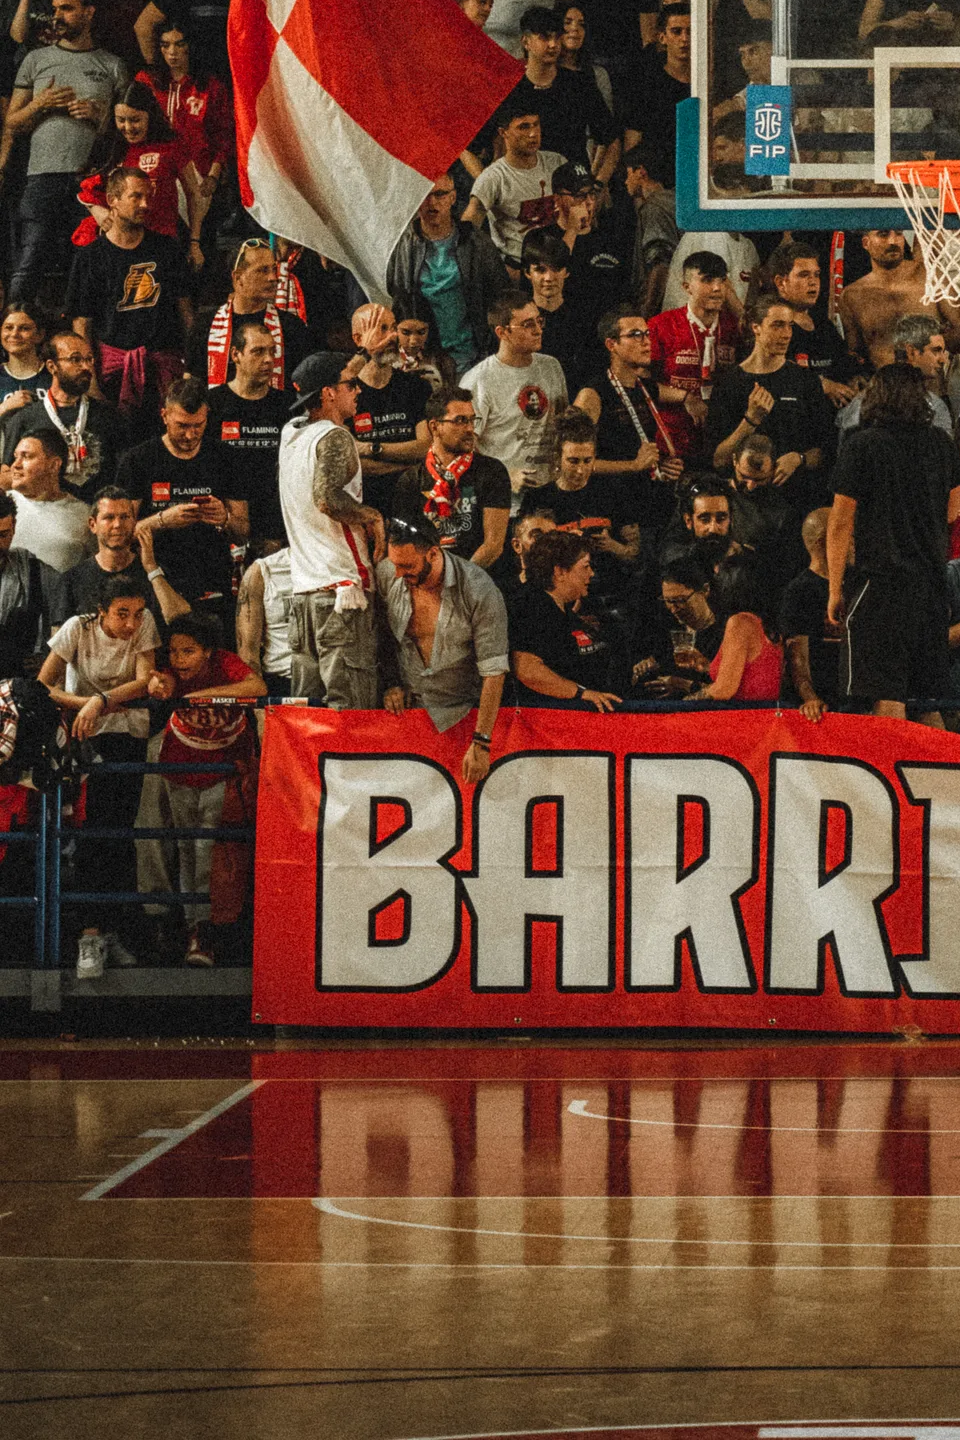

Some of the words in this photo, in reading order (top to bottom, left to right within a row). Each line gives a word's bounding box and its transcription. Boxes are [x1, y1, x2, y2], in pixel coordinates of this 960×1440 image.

[749, 144, 786, 159] FIP
[242, 426, 279, 434] FLAMINIO
[172, 488, 212, 496] FLAMINIO
